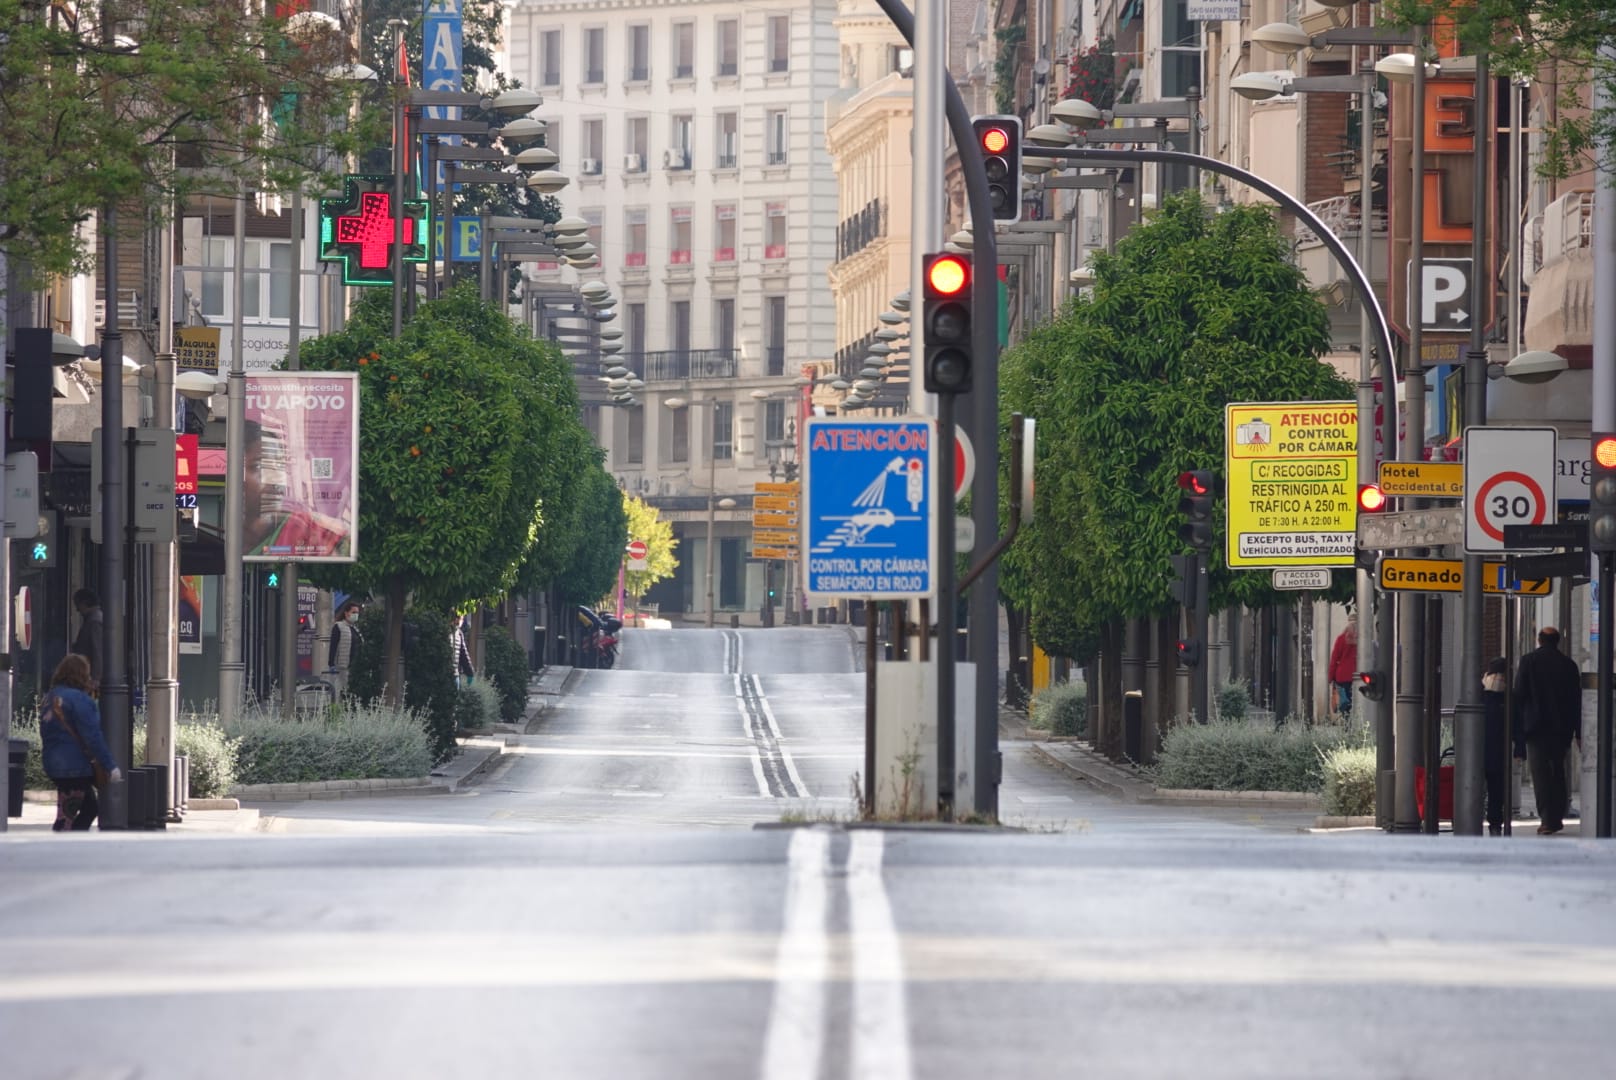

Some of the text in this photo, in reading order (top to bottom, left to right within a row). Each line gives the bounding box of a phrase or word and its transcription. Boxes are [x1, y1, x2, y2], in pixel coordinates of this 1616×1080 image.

[1421, 264, 1467, 324] P
[184, 341, 216, 349] ALQUILA
[246, 383, 344, 392] Saraswathi necesita
[246, 394, 345, 410] TU APOYO
[812, 424, 928, 450] ATENCIÓN
[1288, 428, 1348, 440] CONTROL
[1279, 442, 1304, 452] POR
[1258, 464, 1340, 478] C/ RECOGIDAS
[1383, 468, 1420, 478] Hotel
[1252, 484, 1347, 496] RESTRINGIDA AL
[1382, 482, 1446, 492] Occidental
[1250, 498, 1351, 512] TRÁFICO A 250 m.
[1492, 496, 1530, 518] 30
[1260, 518, 1270, 526] DE
[1273, 517, 1290, 526] 7:30
[1302, 516, 1308, 526] A
[1311, 516, 1332, 526] 22:00
[1247, 534, 1352, 544] EXCEPTO BUS, TAXI Y
[1242, 546, 1293, 554] VEHÍCULOS
[810, 556, 928, 574] CONTROL POR CÁMARA
[1384, 567, 1461, 583] Granado
[817, 574, 922, 590] SEMÁFORO EN ROJO
